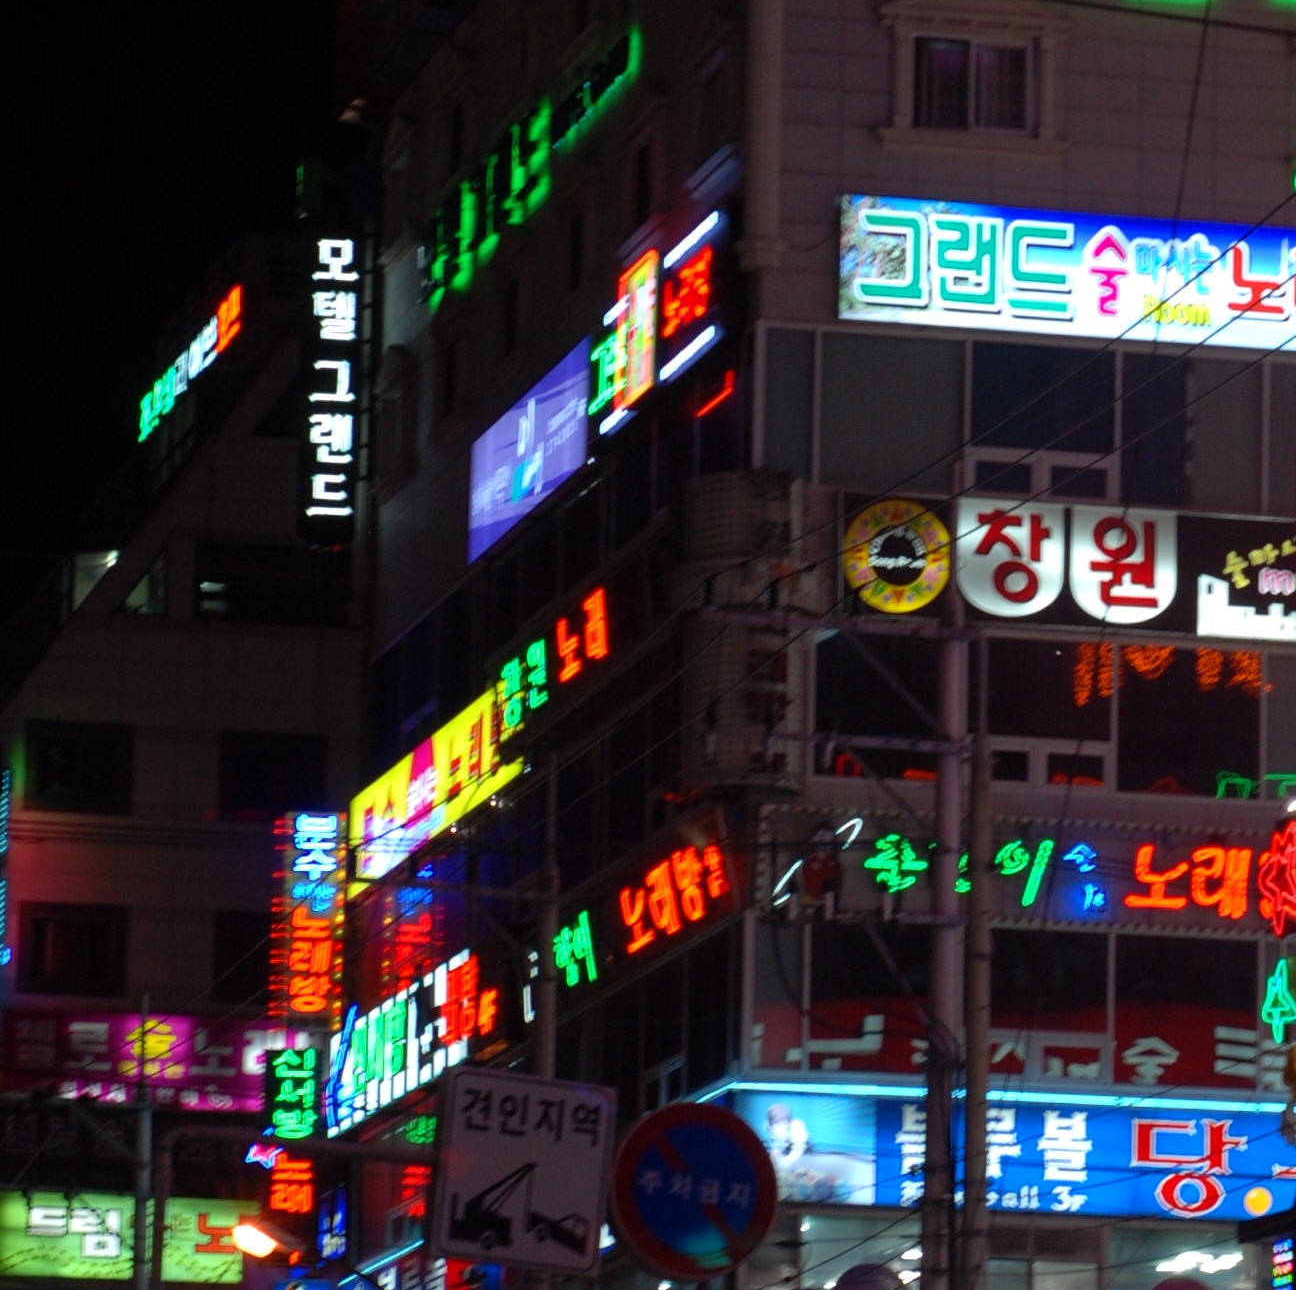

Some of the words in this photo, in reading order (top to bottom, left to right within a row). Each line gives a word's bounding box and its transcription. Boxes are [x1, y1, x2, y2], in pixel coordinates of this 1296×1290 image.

[311, 238, 360, 341] 모텔
[856, 210, 1075, 322] 그랜드
[1144, 295, 1211, 328] Room
[306, 359, 357, 518] 그랜드
[974, 508, 1159, 609] 창원
[619, 844, 706, 956] 노래방
[1124, 844, 1253, 919] 노래
[463, 1088, 602, 1150] 견인지역
[638, 1169, 752, 1209] 주차금지
